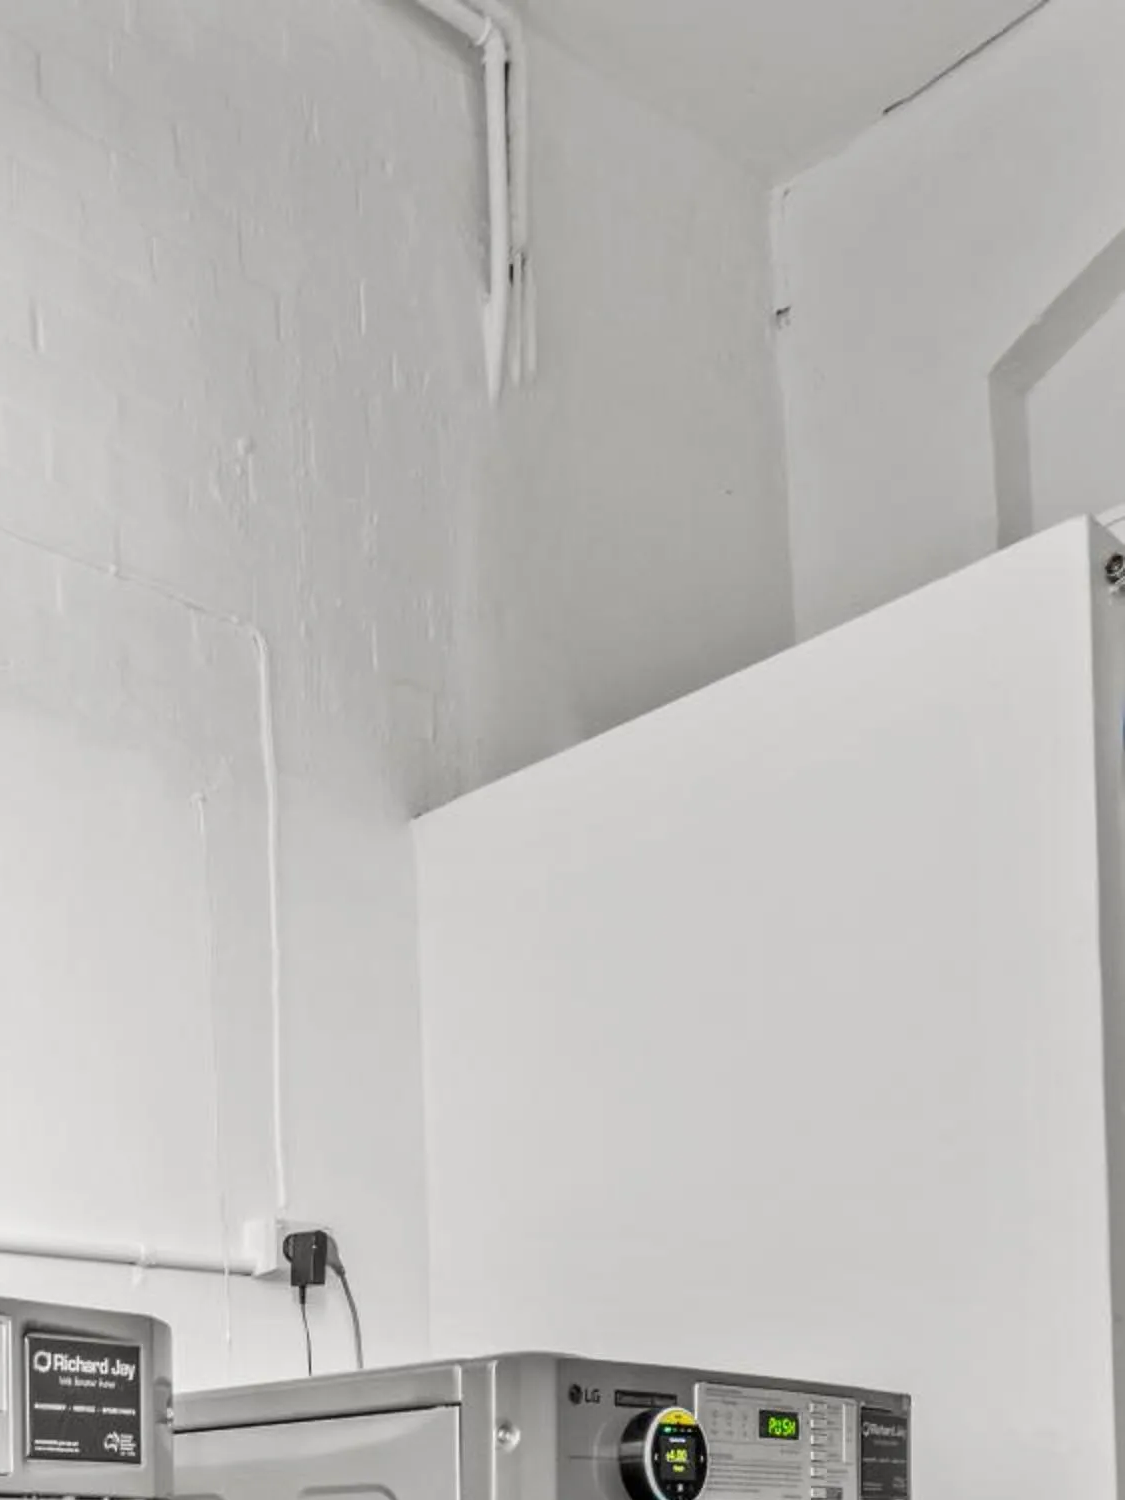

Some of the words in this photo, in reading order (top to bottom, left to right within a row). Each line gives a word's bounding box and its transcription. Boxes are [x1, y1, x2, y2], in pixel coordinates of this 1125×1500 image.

[53, 1353, 109, 1375] Richard
[111, 1359, 136, 1380] Jay
[584, 1388, 601, 1404] LG
[768, 1416, 796, 1437] PUSH
